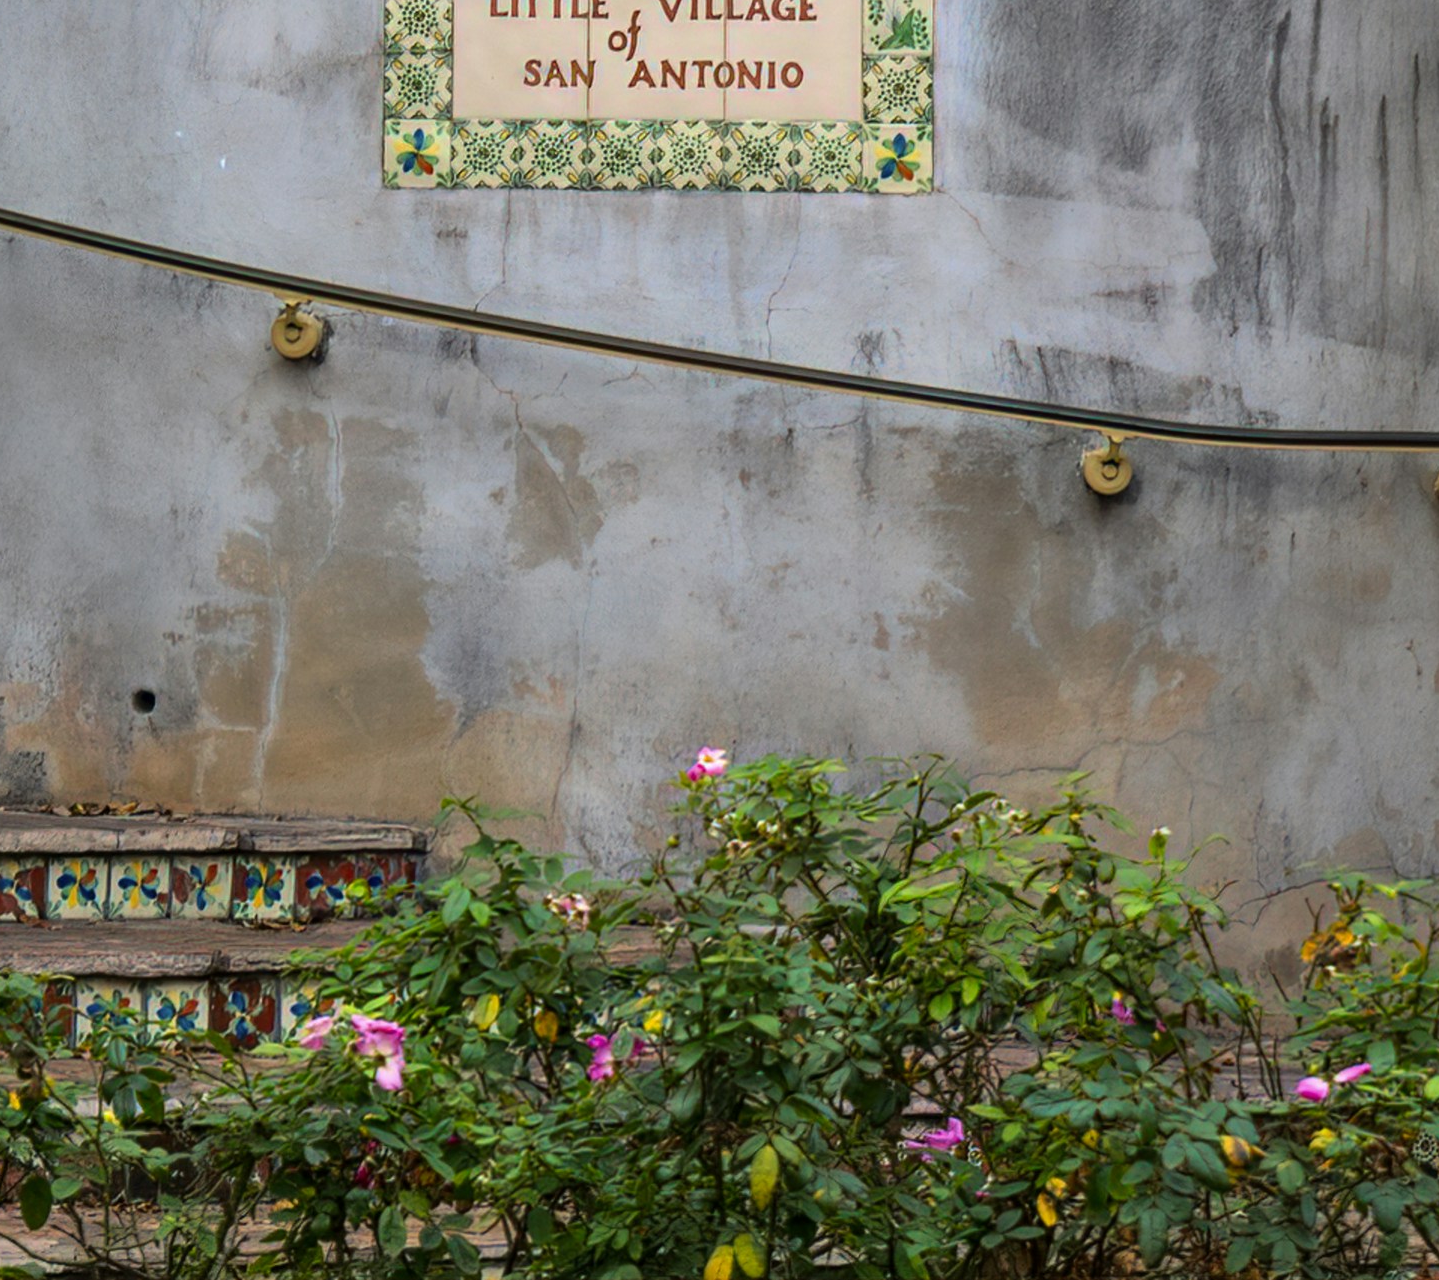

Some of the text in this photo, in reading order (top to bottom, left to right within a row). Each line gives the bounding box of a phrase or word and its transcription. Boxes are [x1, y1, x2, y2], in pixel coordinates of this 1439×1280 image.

[608, 9, 642, 62] of
[523, 58, 805, 90] SAN ANTONIO
